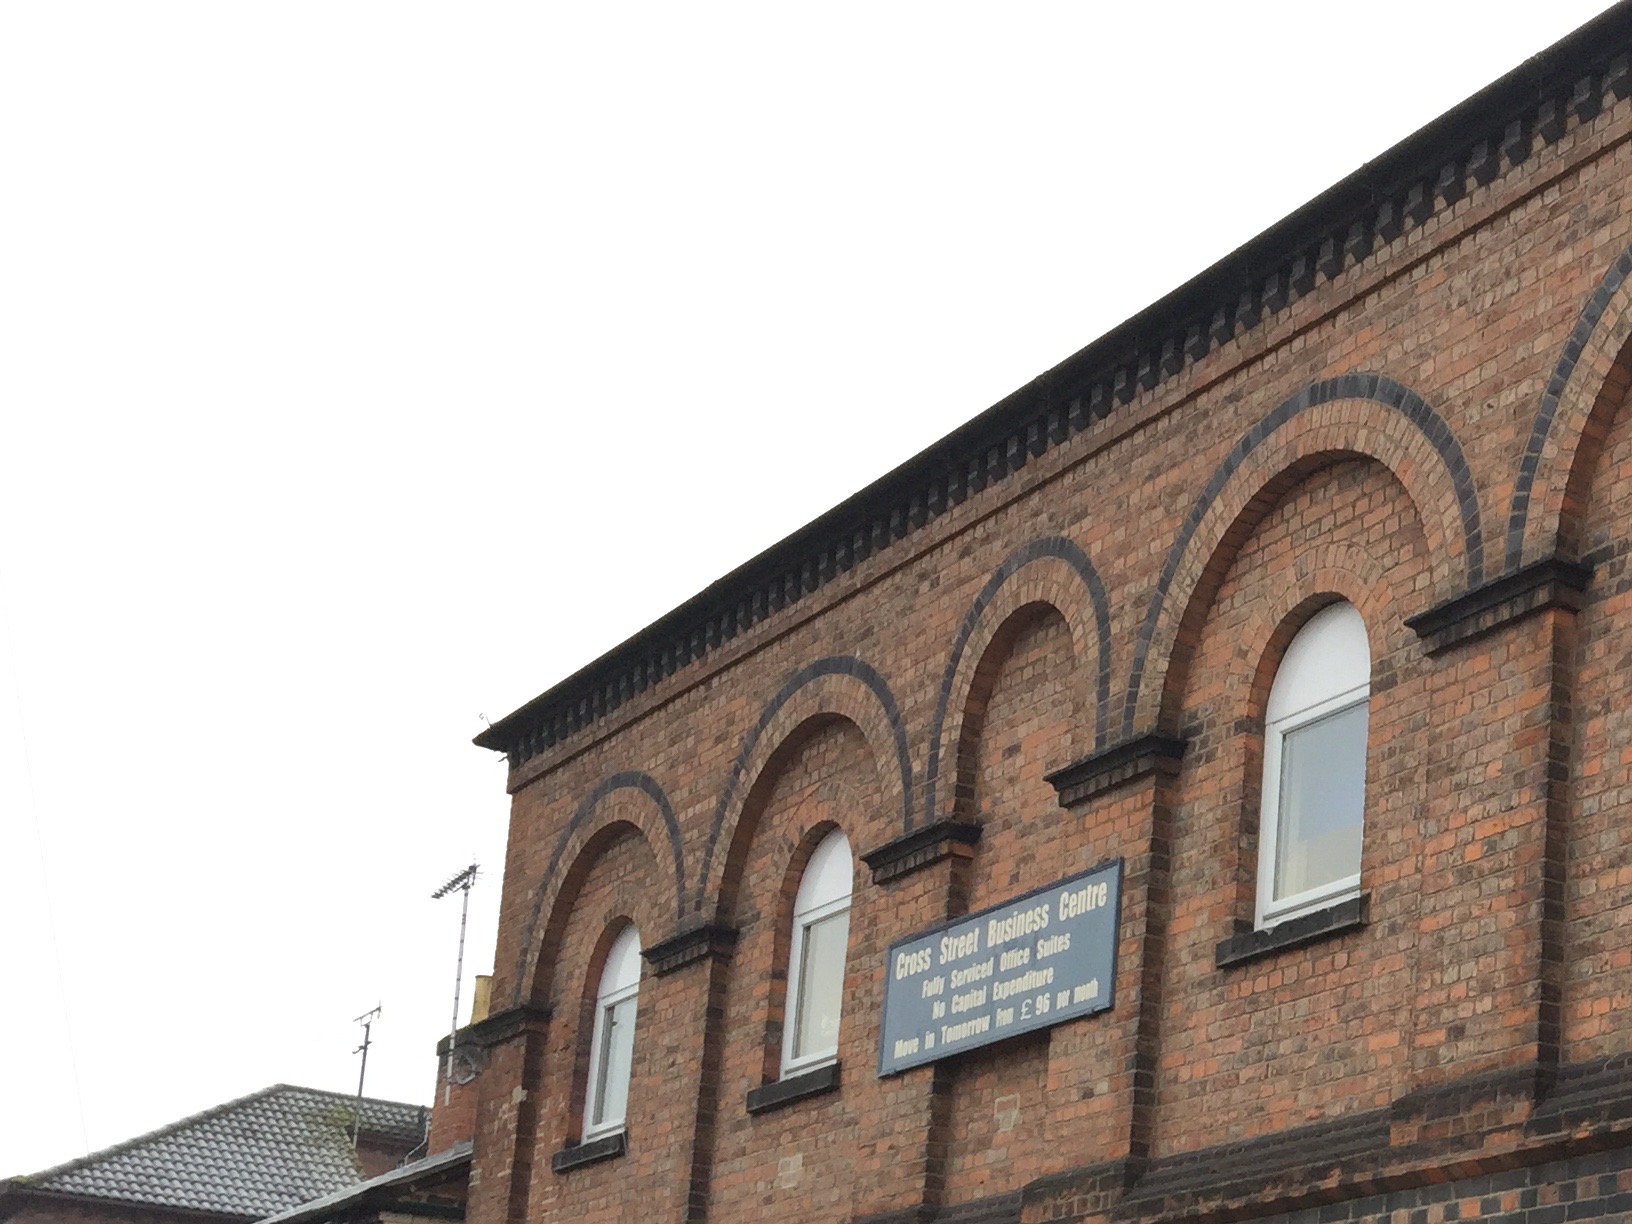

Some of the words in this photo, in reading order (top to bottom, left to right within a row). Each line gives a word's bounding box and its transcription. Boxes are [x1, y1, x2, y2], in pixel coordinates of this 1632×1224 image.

[895, 947, 931, 980] Cross
[939, 927, 979, 965] Street
[987, 904, 1049, 948] Business
[1059, 882, 1108, 921] Centre
[922, 975, 945, 999] Fully
[950, 957, 994, 989] Serviced
[1000, 947, 1030, 972] Office
[1037, 933, 1071, 960] Suites
[894, 1037, 919, 1060] Move
[924, 1030, 935, 1050] in
[941, 1014, 991, 1045] Tomorrow
[1073, 977, 1099, 1004] month
[932, 1000, 946, 1020] No
[951, 985, 987, 1014] Capital
[992, 967, 1054, 1001] Expenditure
